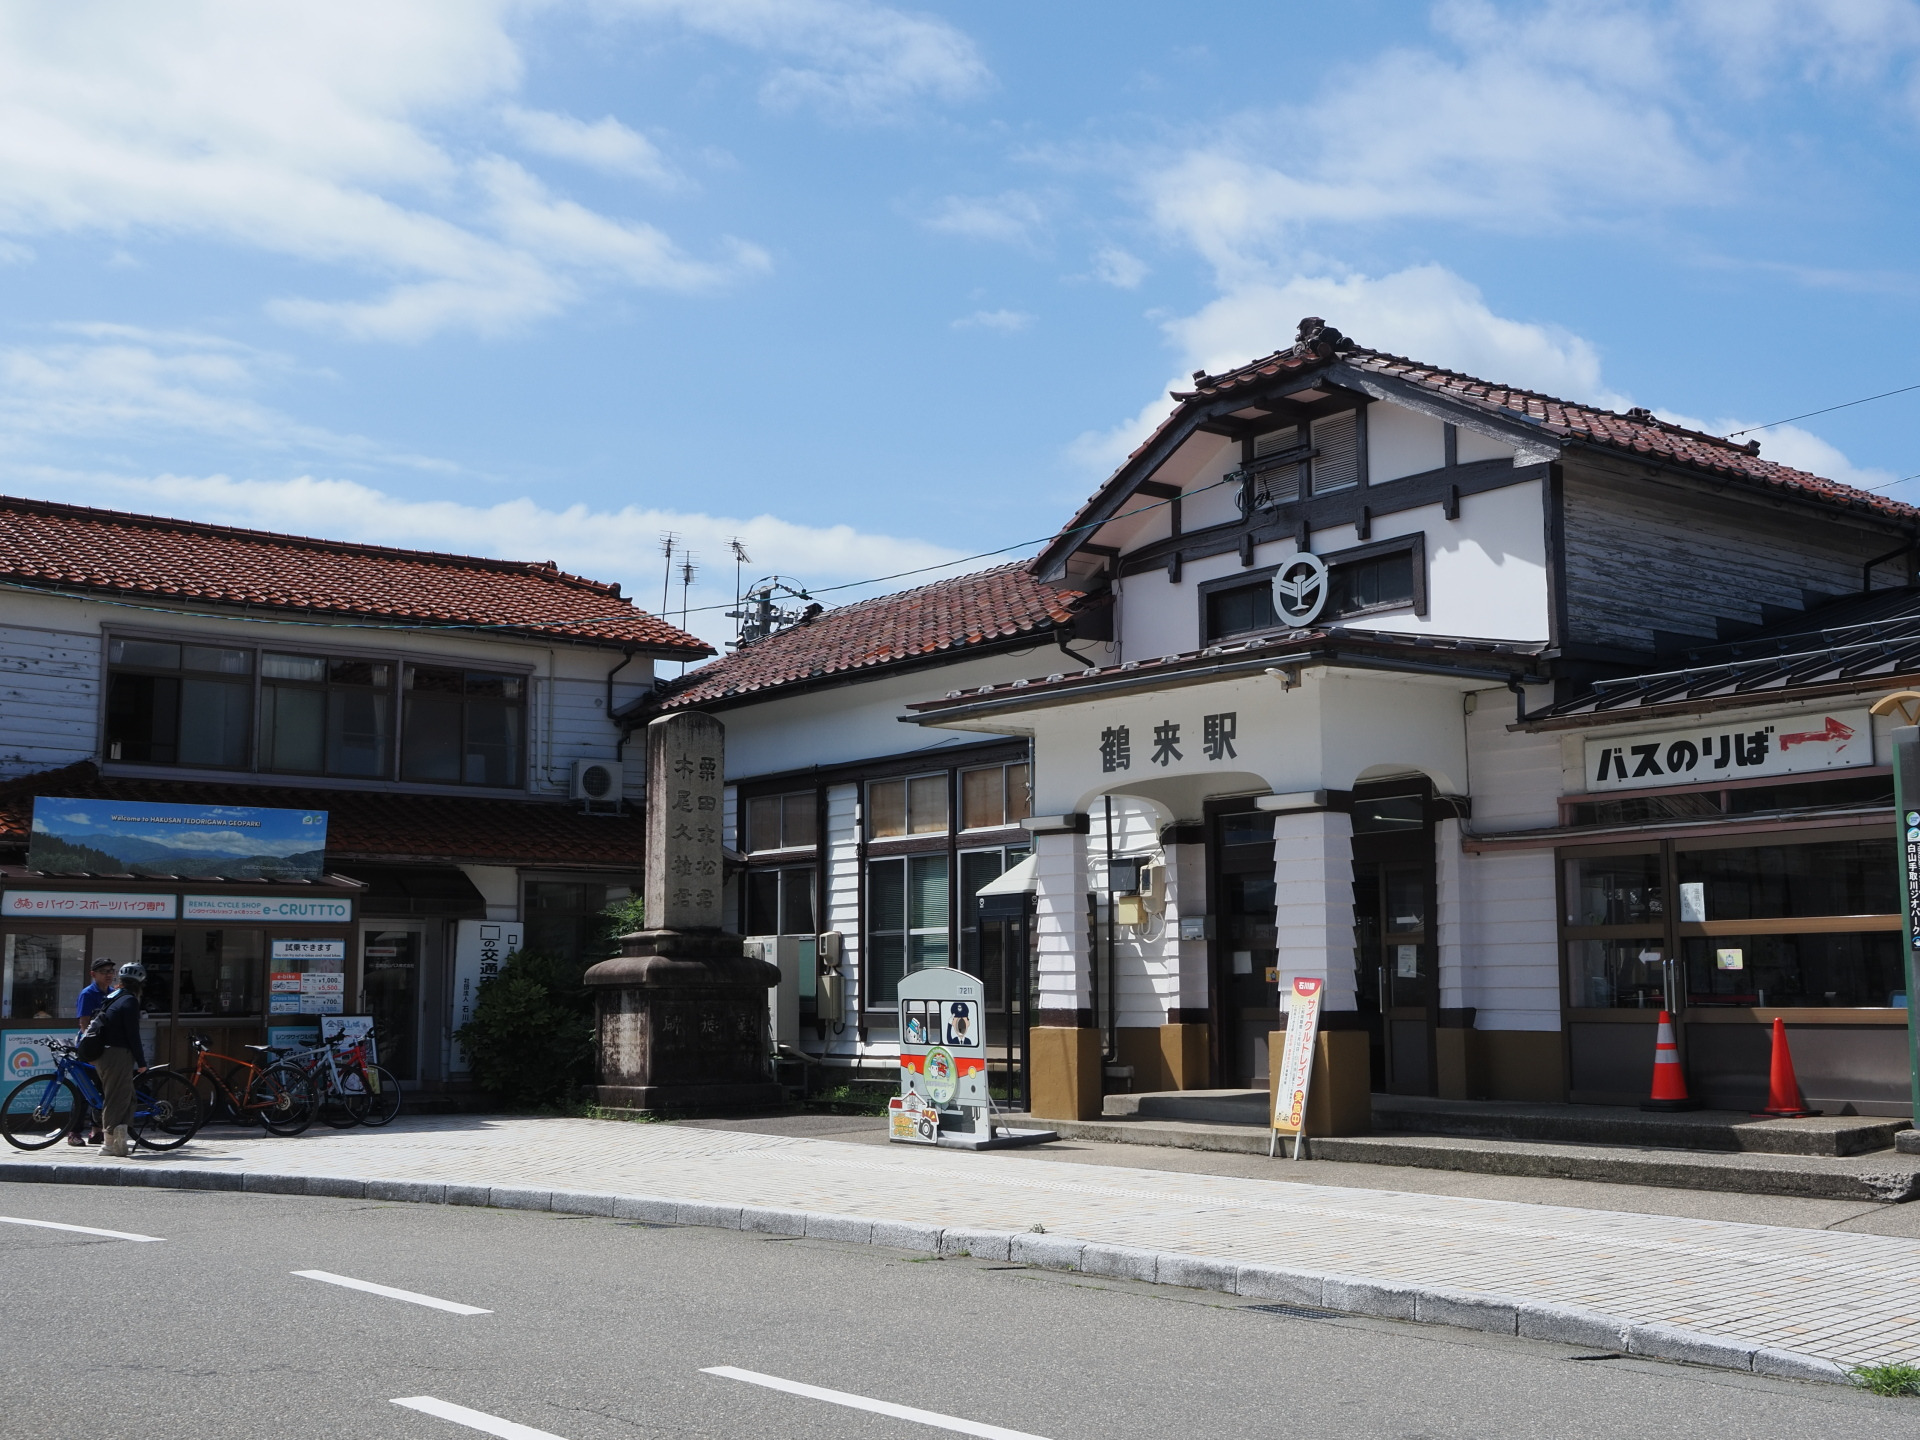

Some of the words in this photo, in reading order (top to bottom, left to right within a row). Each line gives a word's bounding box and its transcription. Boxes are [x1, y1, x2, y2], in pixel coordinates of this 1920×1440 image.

[1099, 711, 1238, 773] 鶴来駅
[1596, 725, 1775, 782] バスのりば
[111, 814, 140, 823] Welcome
[150, 816, 182, 825] HAKUSAN
[183, 817, 227, 826] TEDORIGAWA
[1907, 843, 1920, 935] 白山手取川ジオパーク
[36, 899, 166, 912] eバイク・スポーツバイク専門
[263, 903, 346, 917] e-CRUTTTO
[285, 943, 333, 952] 試乗できます
[959, 987, 973, 995] 7211
[1296, 999, 1316, 1087] サイクルトレイン
